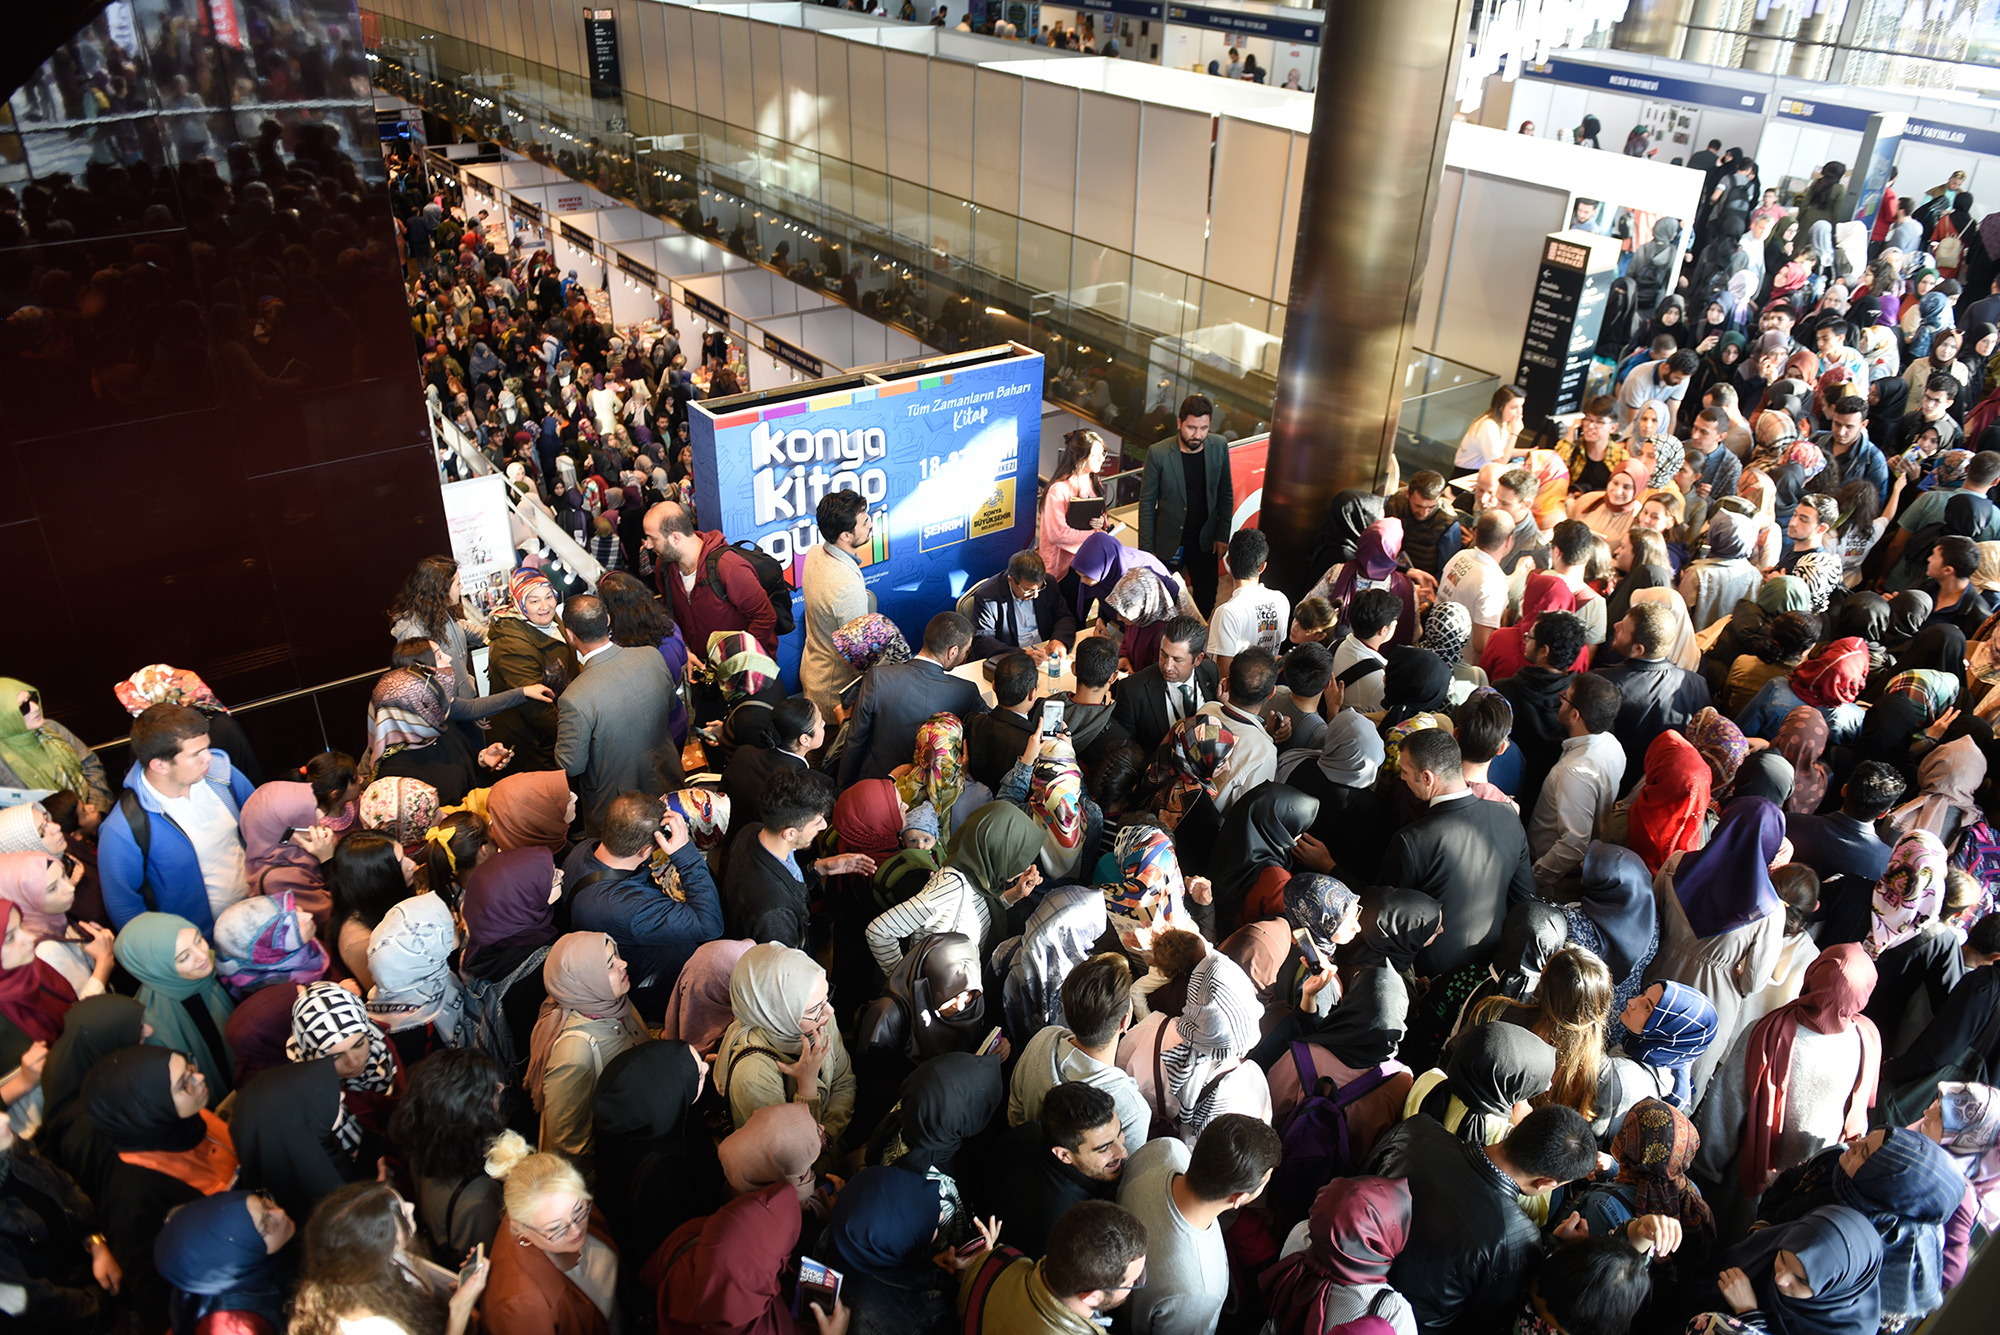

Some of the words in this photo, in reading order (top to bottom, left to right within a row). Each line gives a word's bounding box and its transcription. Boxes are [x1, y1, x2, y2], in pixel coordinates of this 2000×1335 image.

[1903, 122, 1923, 136] ALBİ
[1922, 126, 1967, 143] YAYINLARI
[907, 403, 930, 417] Tüm
[931, 391, 995, 412] Zamanların
[996, 383, 1031, 399] Baharı
[953, 405, 988, 432] Kitap
[751, 421, 886, 471] konya
[753, 464, 887, 527] kitap
[973, 511, 1011, 528] BÜYÜKŞEHİR
[983, 508, 1002, 518] KONYA
